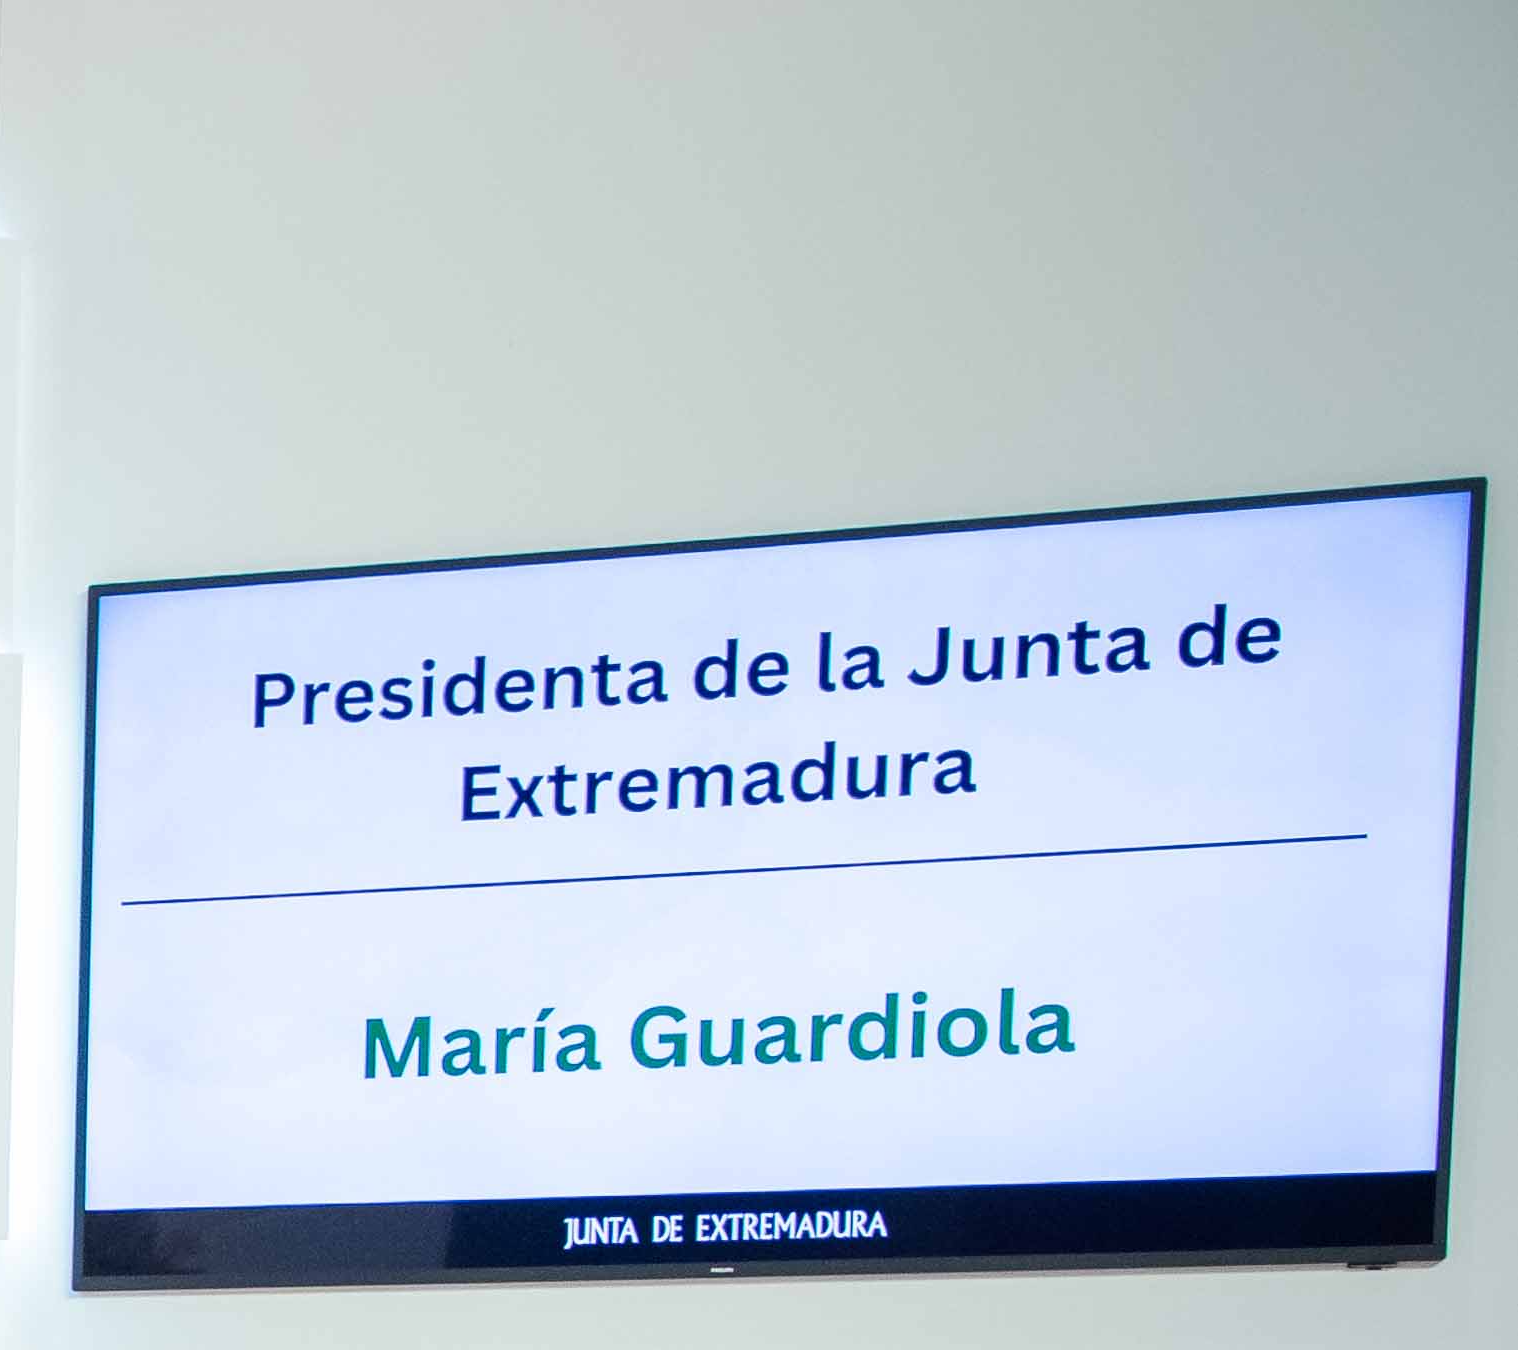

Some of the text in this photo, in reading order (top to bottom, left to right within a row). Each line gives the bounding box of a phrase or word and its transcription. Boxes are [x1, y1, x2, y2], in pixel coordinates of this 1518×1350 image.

[253, 603, 1283, 728] Presidenta de la Junta de
[460, 740, 978, 822] Extremadura
[364, 987, 1077, 1080] María Guardiola
[563, 1210, 889, 1250] JUNTA DE EXTREMADURA
